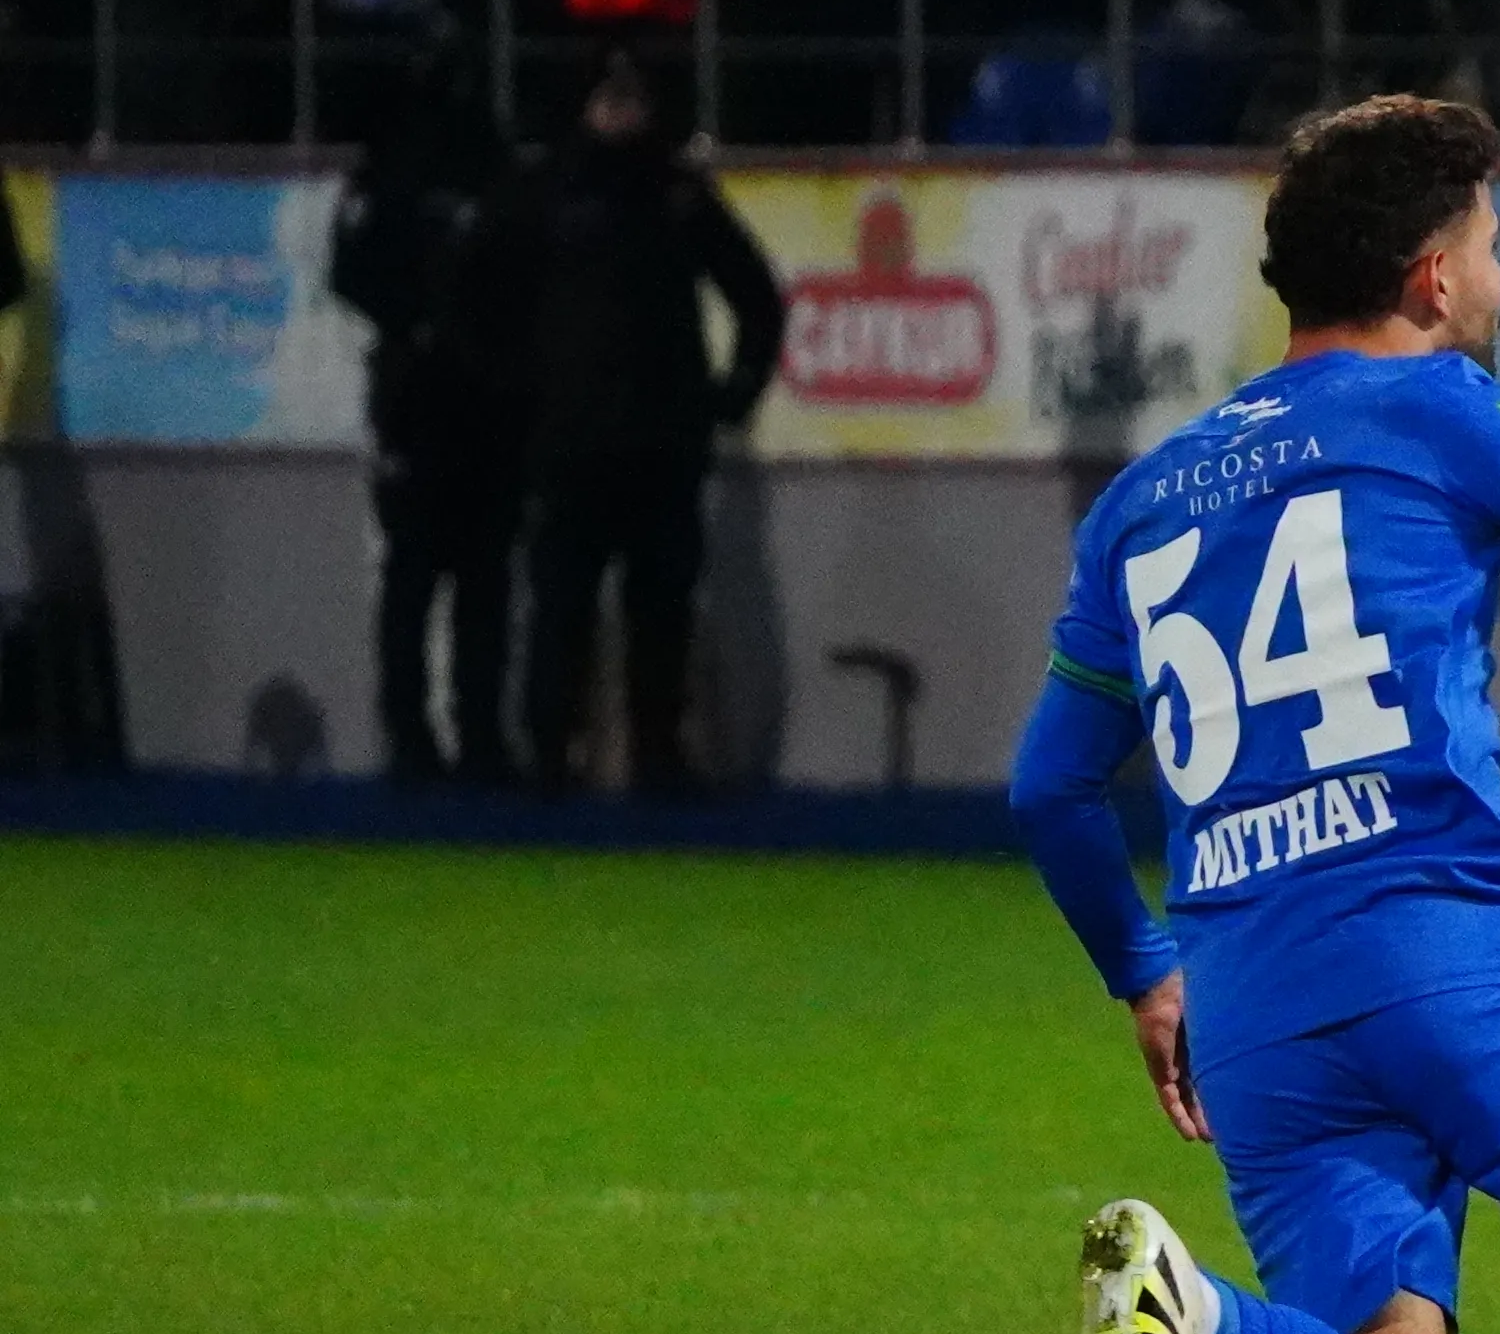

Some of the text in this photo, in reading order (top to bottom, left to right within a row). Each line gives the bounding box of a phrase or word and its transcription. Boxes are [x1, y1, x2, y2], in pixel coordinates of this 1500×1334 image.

[1153, 436, 1323, 504] RICOSTA
[1190, 475, 1275, 516] HOTEL
[1125, 489, 1411, 806] 54
[1187, 772, 1398, 894] MITHAT
